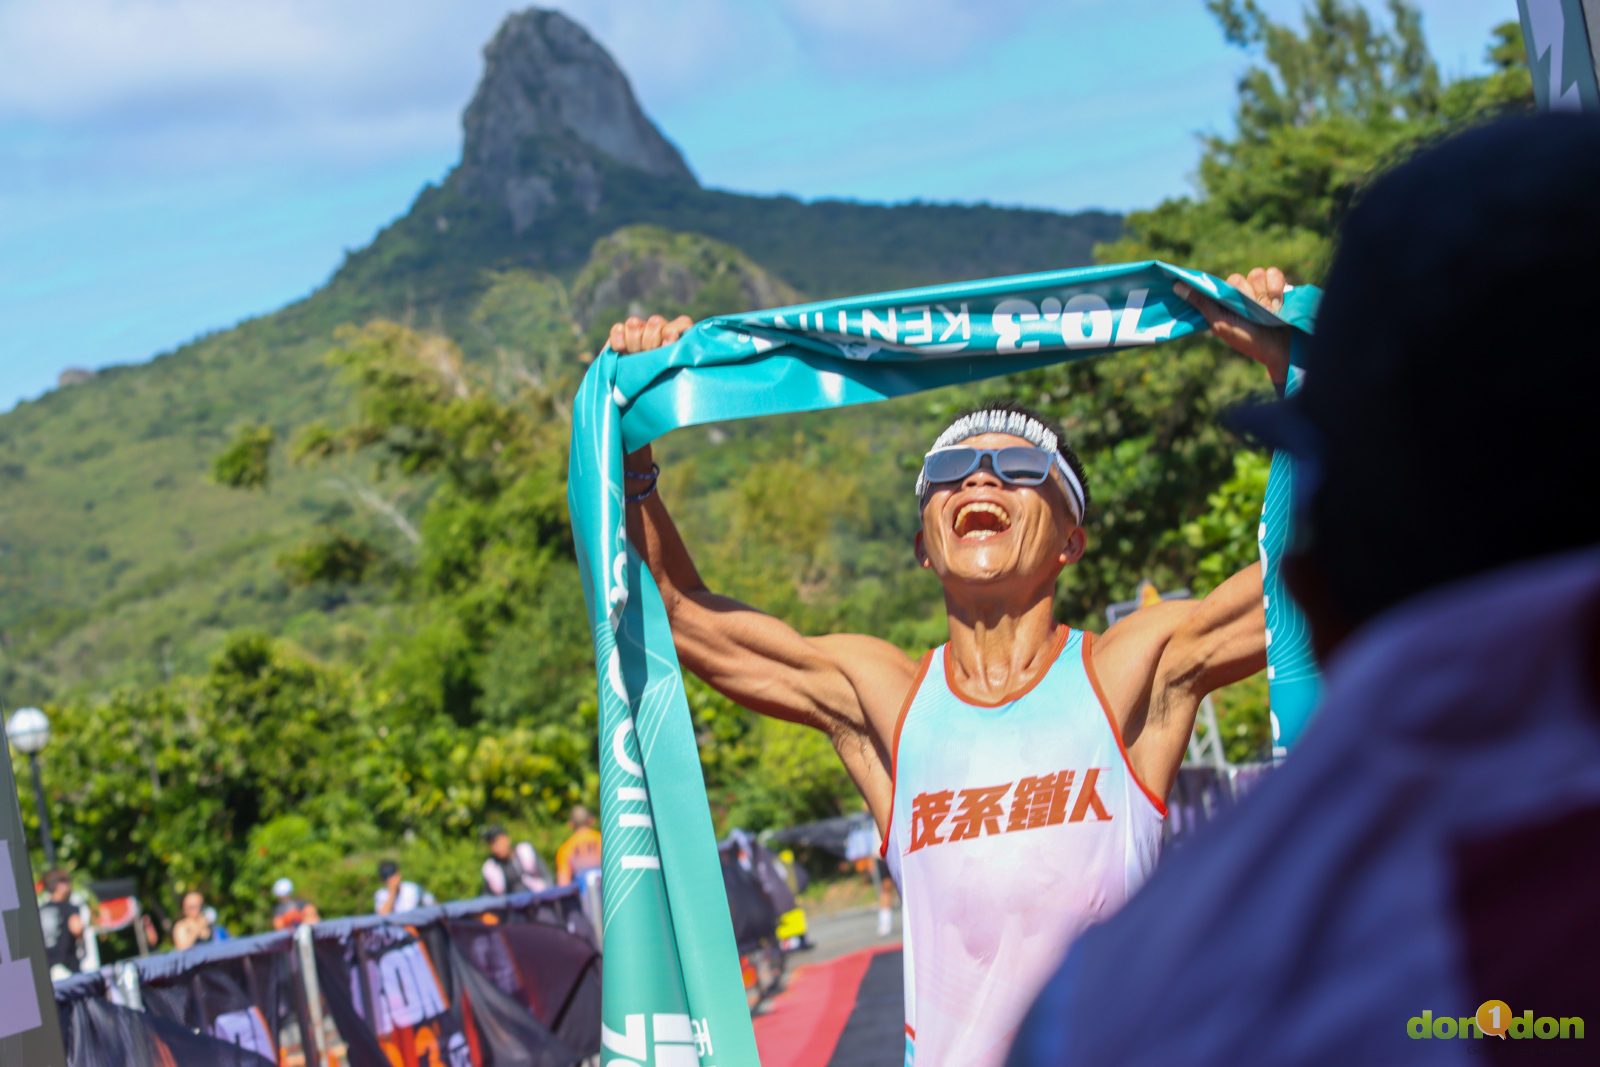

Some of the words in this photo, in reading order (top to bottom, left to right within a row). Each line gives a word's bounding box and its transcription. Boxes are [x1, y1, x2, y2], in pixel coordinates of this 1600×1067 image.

[991, 288, 1172, 354] 70.3
[903, 768, 1113, 857] 茂系鐵人
